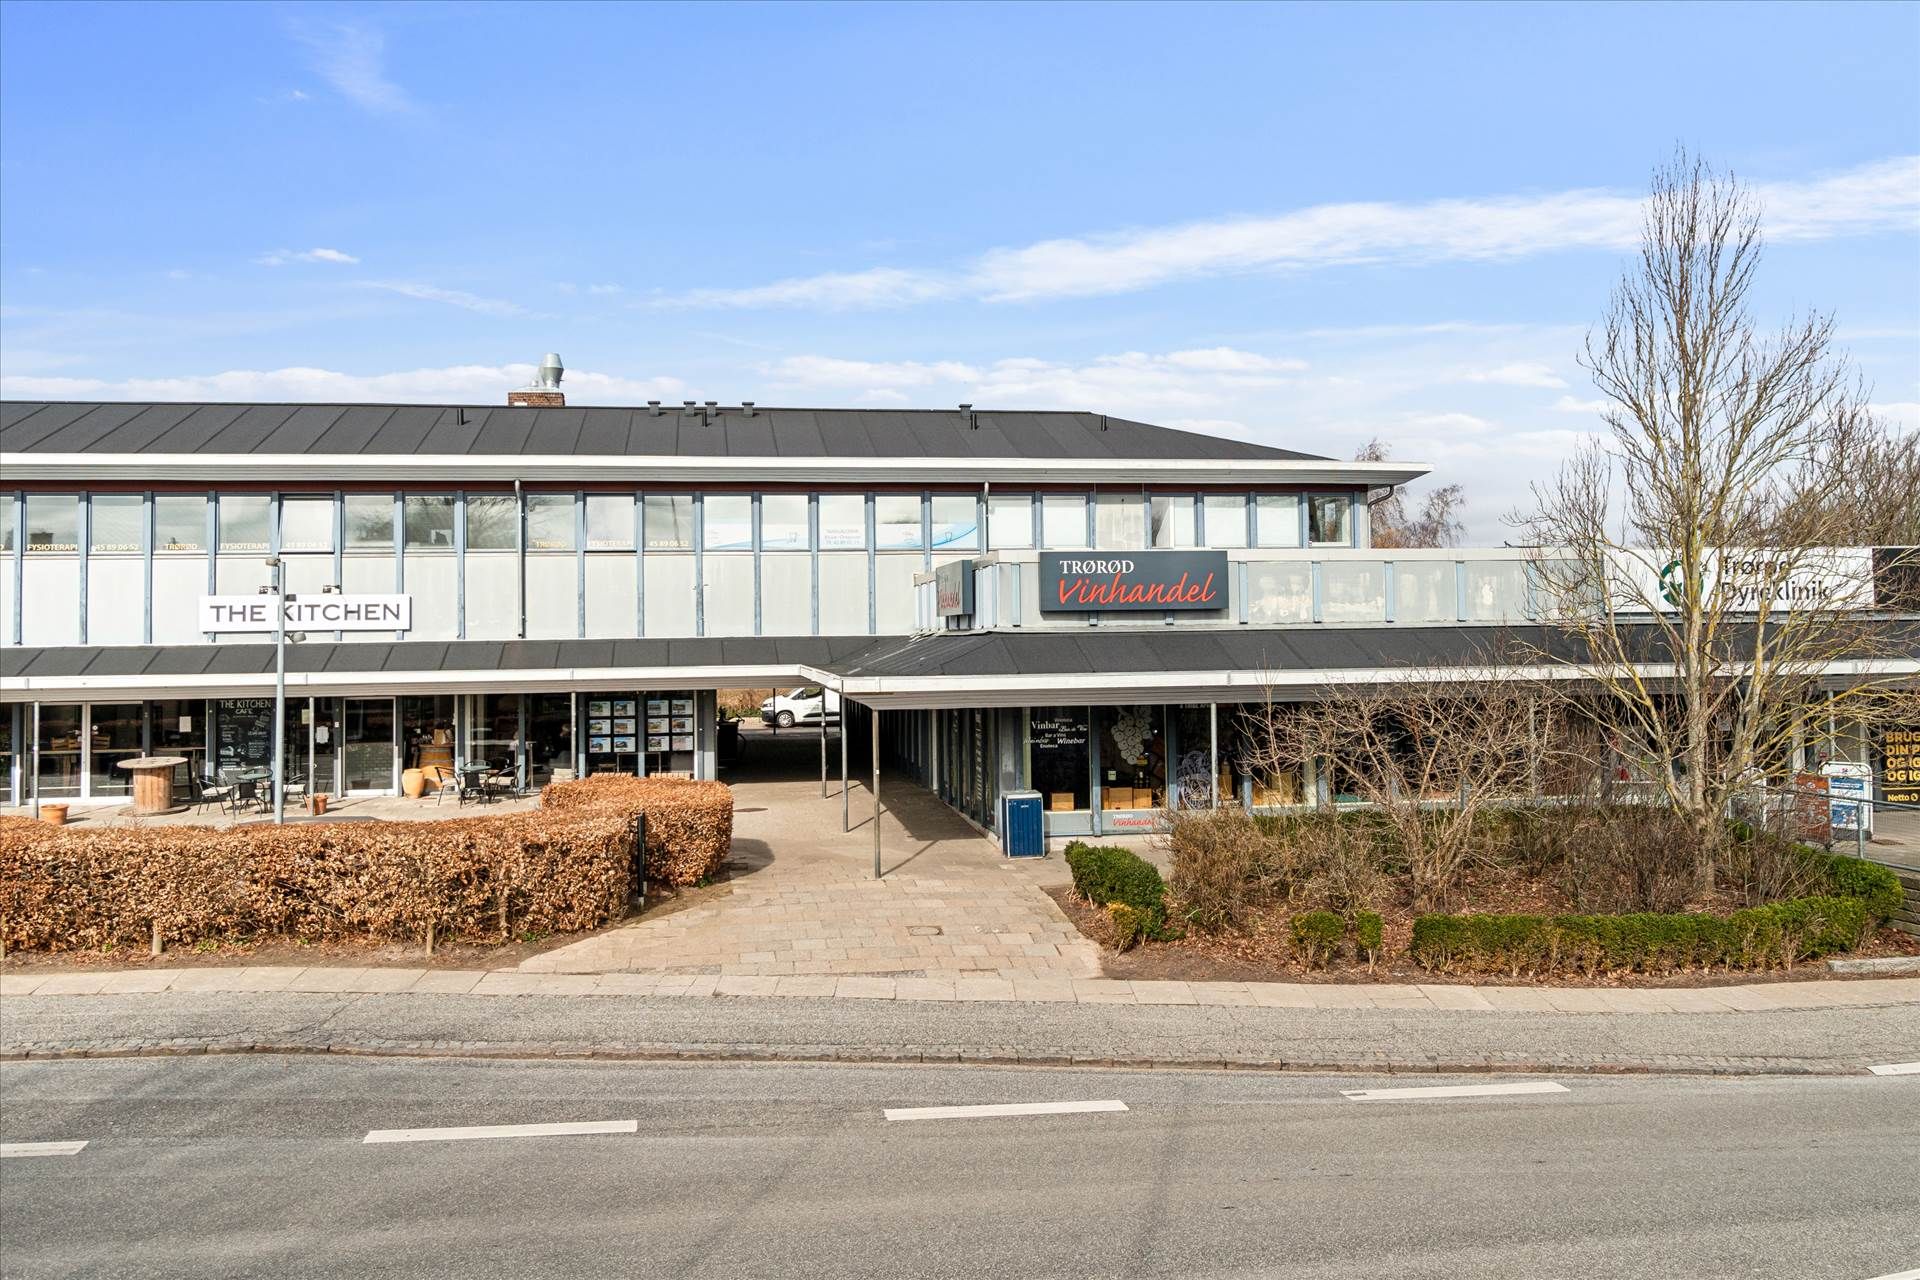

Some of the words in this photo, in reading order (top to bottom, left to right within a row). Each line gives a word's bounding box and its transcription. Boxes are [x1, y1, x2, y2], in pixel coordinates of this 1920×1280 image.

[27, 543, 78, 551] FYSIOTERAPI
[220, 542, 270, 550] FYSIOTERAPI
[1059, 559, 1135, 575] TRØRØD
[1058, 571, 1217, 605] Vinhandel
[209, 604, 266, 622] THE
[277, 603, 401, 621] KITCHEN
[220, 699, 235, 709] THE
[236, 699, 272, 709] KITCHEN
[1031, 720, 1060, 730] Vinbar
[1057, 737, 1086, 745] Winebar
[1886, 744, 1908, 755] DIN
[1886, 757, 1906, 768] OG
[1887, 770, 1907, 781] OG
[1887, 793, 1910, 802] Netto
